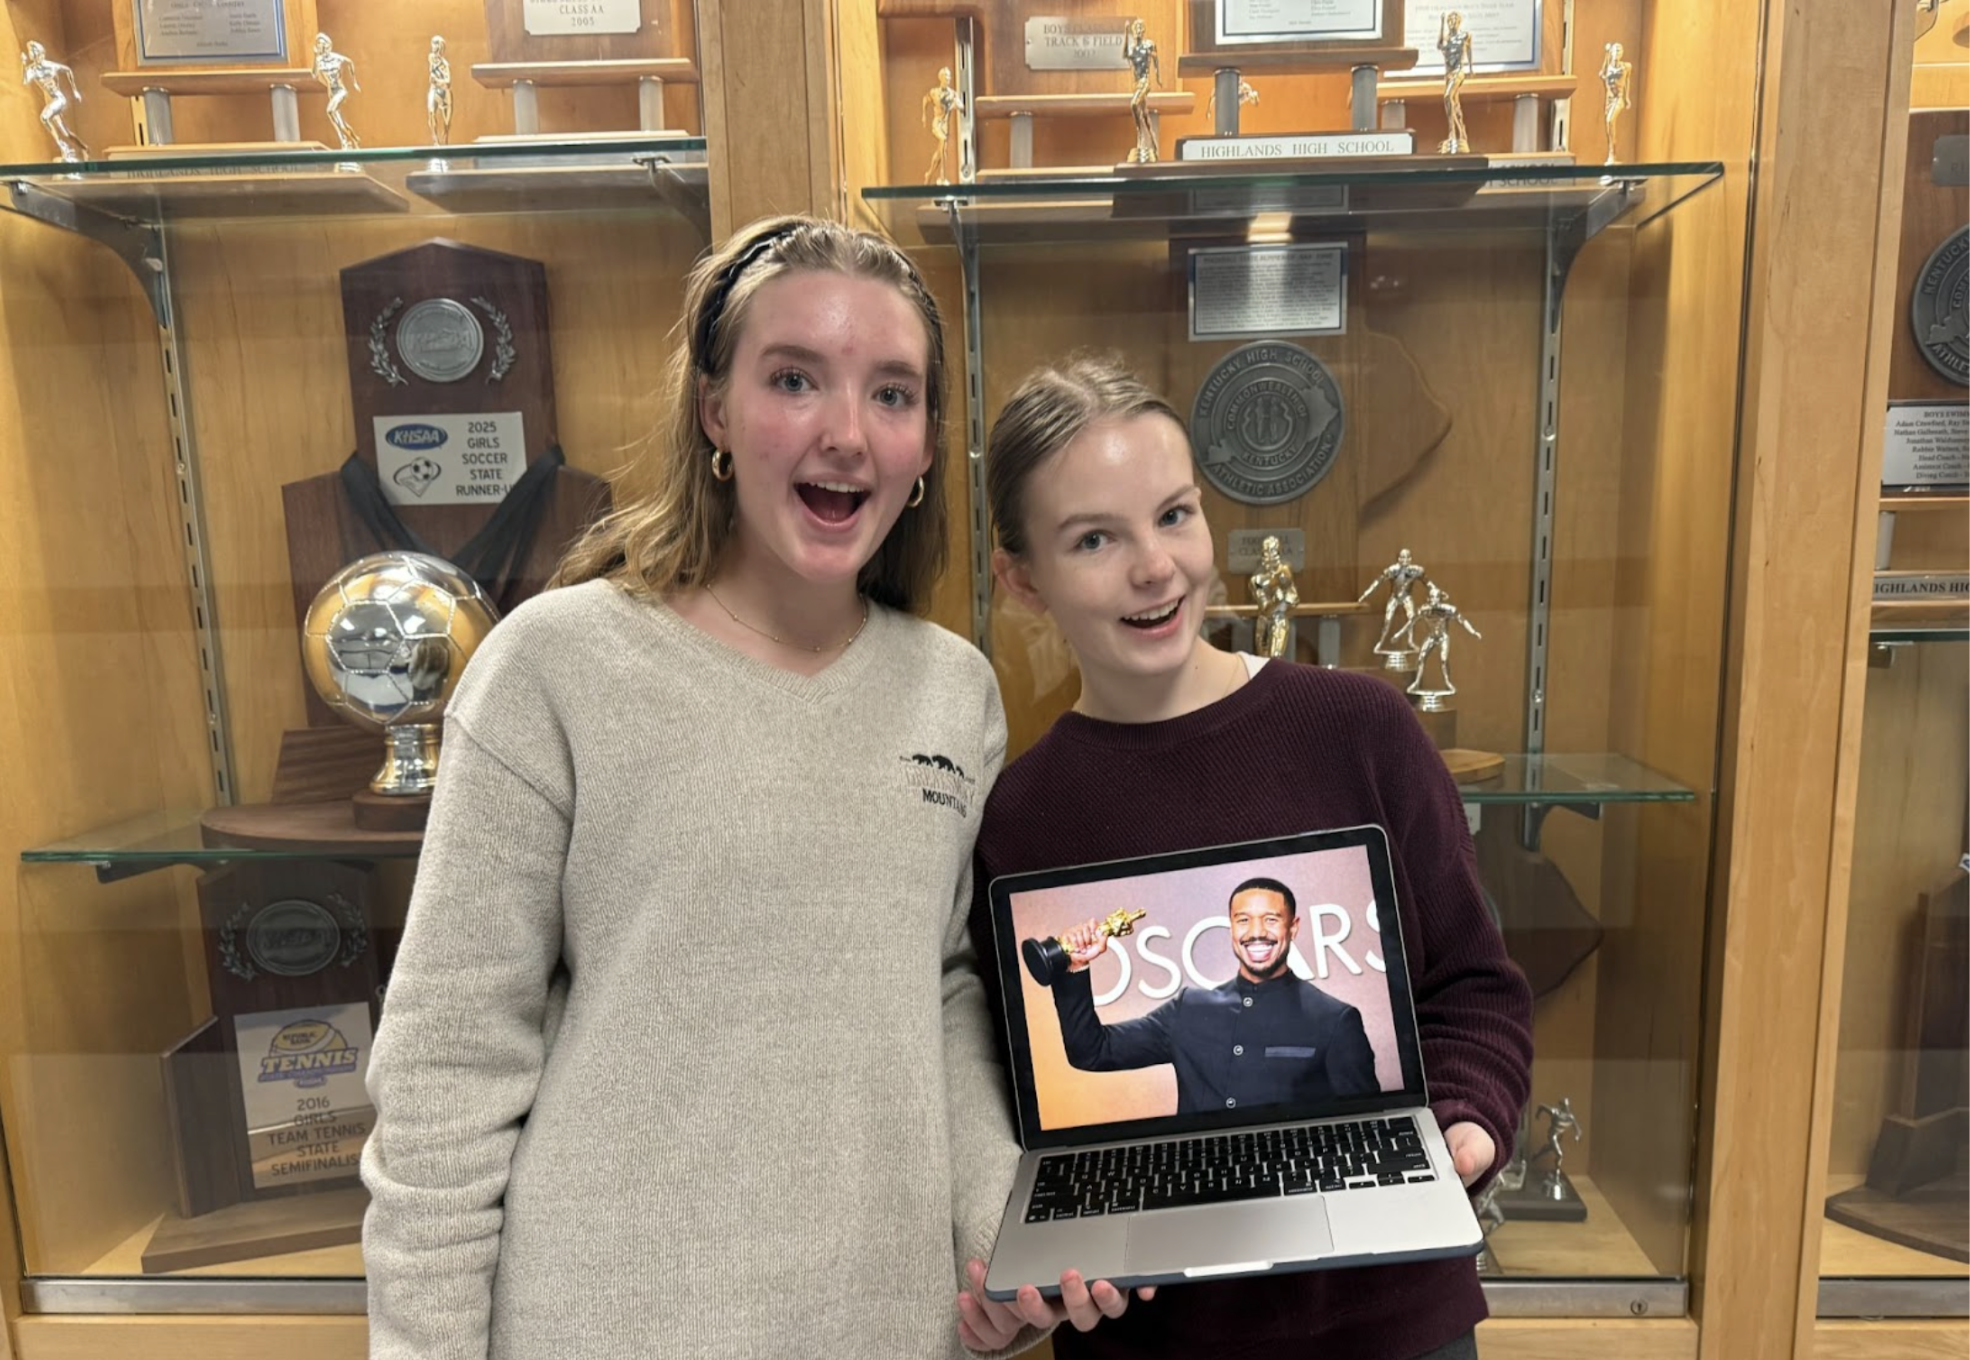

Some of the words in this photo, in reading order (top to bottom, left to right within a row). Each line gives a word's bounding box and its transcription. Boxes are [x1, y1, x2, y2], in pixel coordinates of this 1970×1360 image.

[559, 4, 589, 15] CLASS
[592, 4, 605, 15] AA
[1045, 36, 1079, 47] TRACK
[1093, 35, 1123, 46] FIELD
[1201, 144, 1282, 158] HIGHLANDS
[1293, 143, 1327, 155] HIGH
[1338, 141, 1394, 154] SCHOOL
[1200, 358, 1242, 417] KENTUCKY
[1246, 348, 1278, 364] HIGH
[1284, 351, 1325, 385] SCHOOL
[1228, 381, 1298, 431] COMMONWEALTH
[468, 421, 497, 433] 2025
[393, 430, 441, 444] KHSAA
[467, 437, 500, 449] GIRLS
[462, 452, 508, 465] SOCCER
[1242, 445, 1297, 467] KENTUCKY
[470, 469, 502, 480] STATE
[1211, 463, 1264, 495] ATHLETIC
[1267, 442, 1333, 496] ASSOCIATION
[456, 484, 513, 497] RUNNER-U
[1873, 582, 1947, 594] IGHLANDS
[922, 787, 967, 819] MOUNT
[262, 1049, 357, 1074] TENNIS
[297, 1096, 330, 1111] 2016
[294, 1111, 337, 1127] GIRLS
[267, 1130, 308, 1146] TEAM
[314, 1122, 365, 1139] TENNIS
[296, 1141, 340, 1158] STATE
[271, 1153, 360, 1176] SEMIFINALIS
